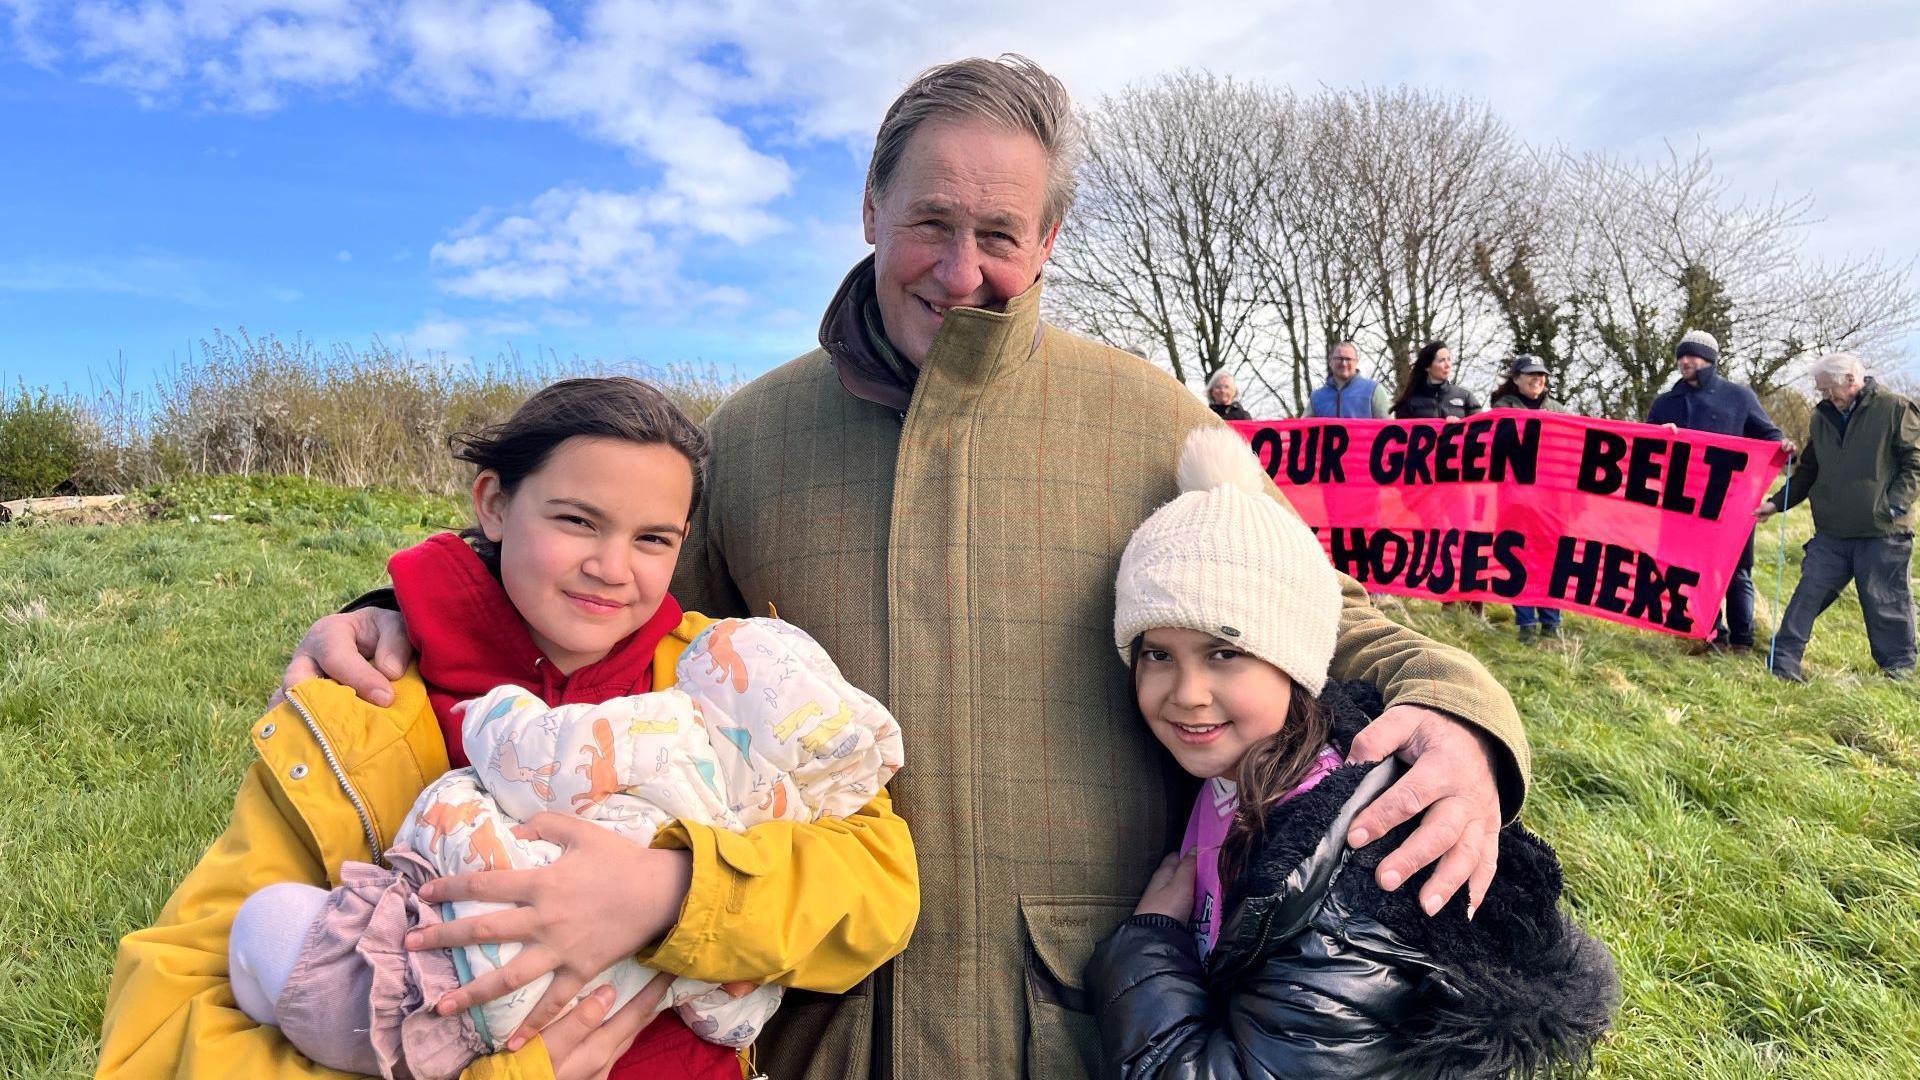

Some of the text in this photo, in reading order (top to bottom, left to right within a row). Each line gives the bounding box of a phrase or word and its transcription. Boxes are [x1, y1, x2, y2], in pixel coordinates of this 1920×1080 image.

[1252, 418, 1748, 521] OUR GREEN BELT
[1331, 528, 1700, 633] HOUSES HERE
